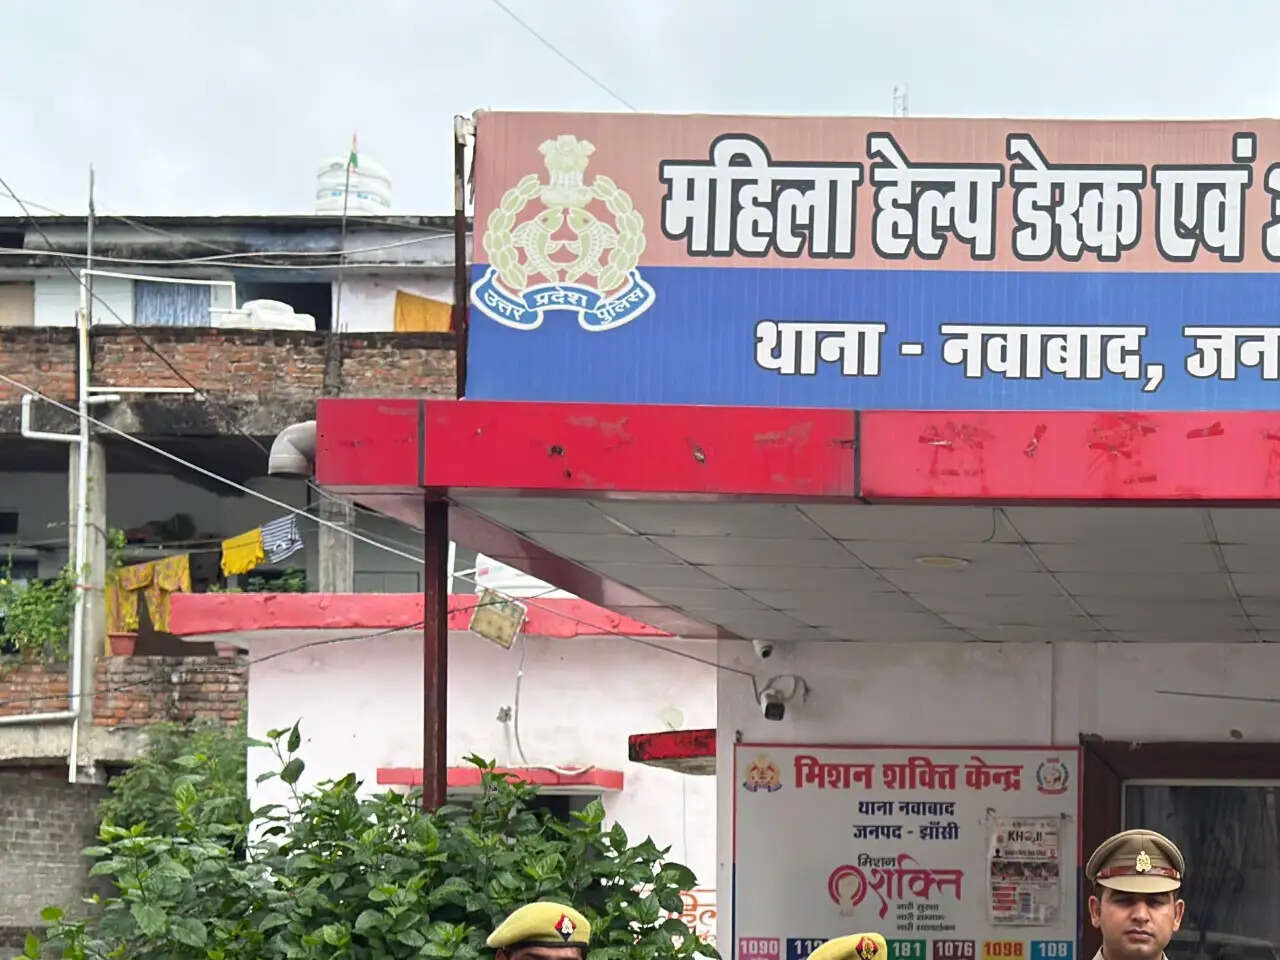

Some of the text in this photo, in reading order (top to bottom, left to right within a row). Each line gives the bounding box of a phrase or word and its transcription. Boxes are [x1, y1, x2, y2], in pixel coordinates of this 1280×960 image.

[660, 133, 864, 258] महिला
[867, 132, 1004, 260] हेल्प
[1006, 133, 1147, 262] डेस्क
[1152, 132, 1256, 262] एवं
[484, 285, 644, 324] उत्तर प्रदेश पुलिस
[754, 319, 886, 377] थाना
[940, 325, 1164, 392] नवाबाद,
[794, 754, 1024, 792] मिशन शक्ति केन्द्र
[858, 801, 956, 816] थाना नवाबाद
[853, 825, 902, 839] जनपद
[858, 853, 896, 867] मिशन
[740, 940, 778, 954] 1090
[893, 941, 921, 957] 181
[936, 942, 973, 957] 1076
[1039, 942, 1068, 957] 108
